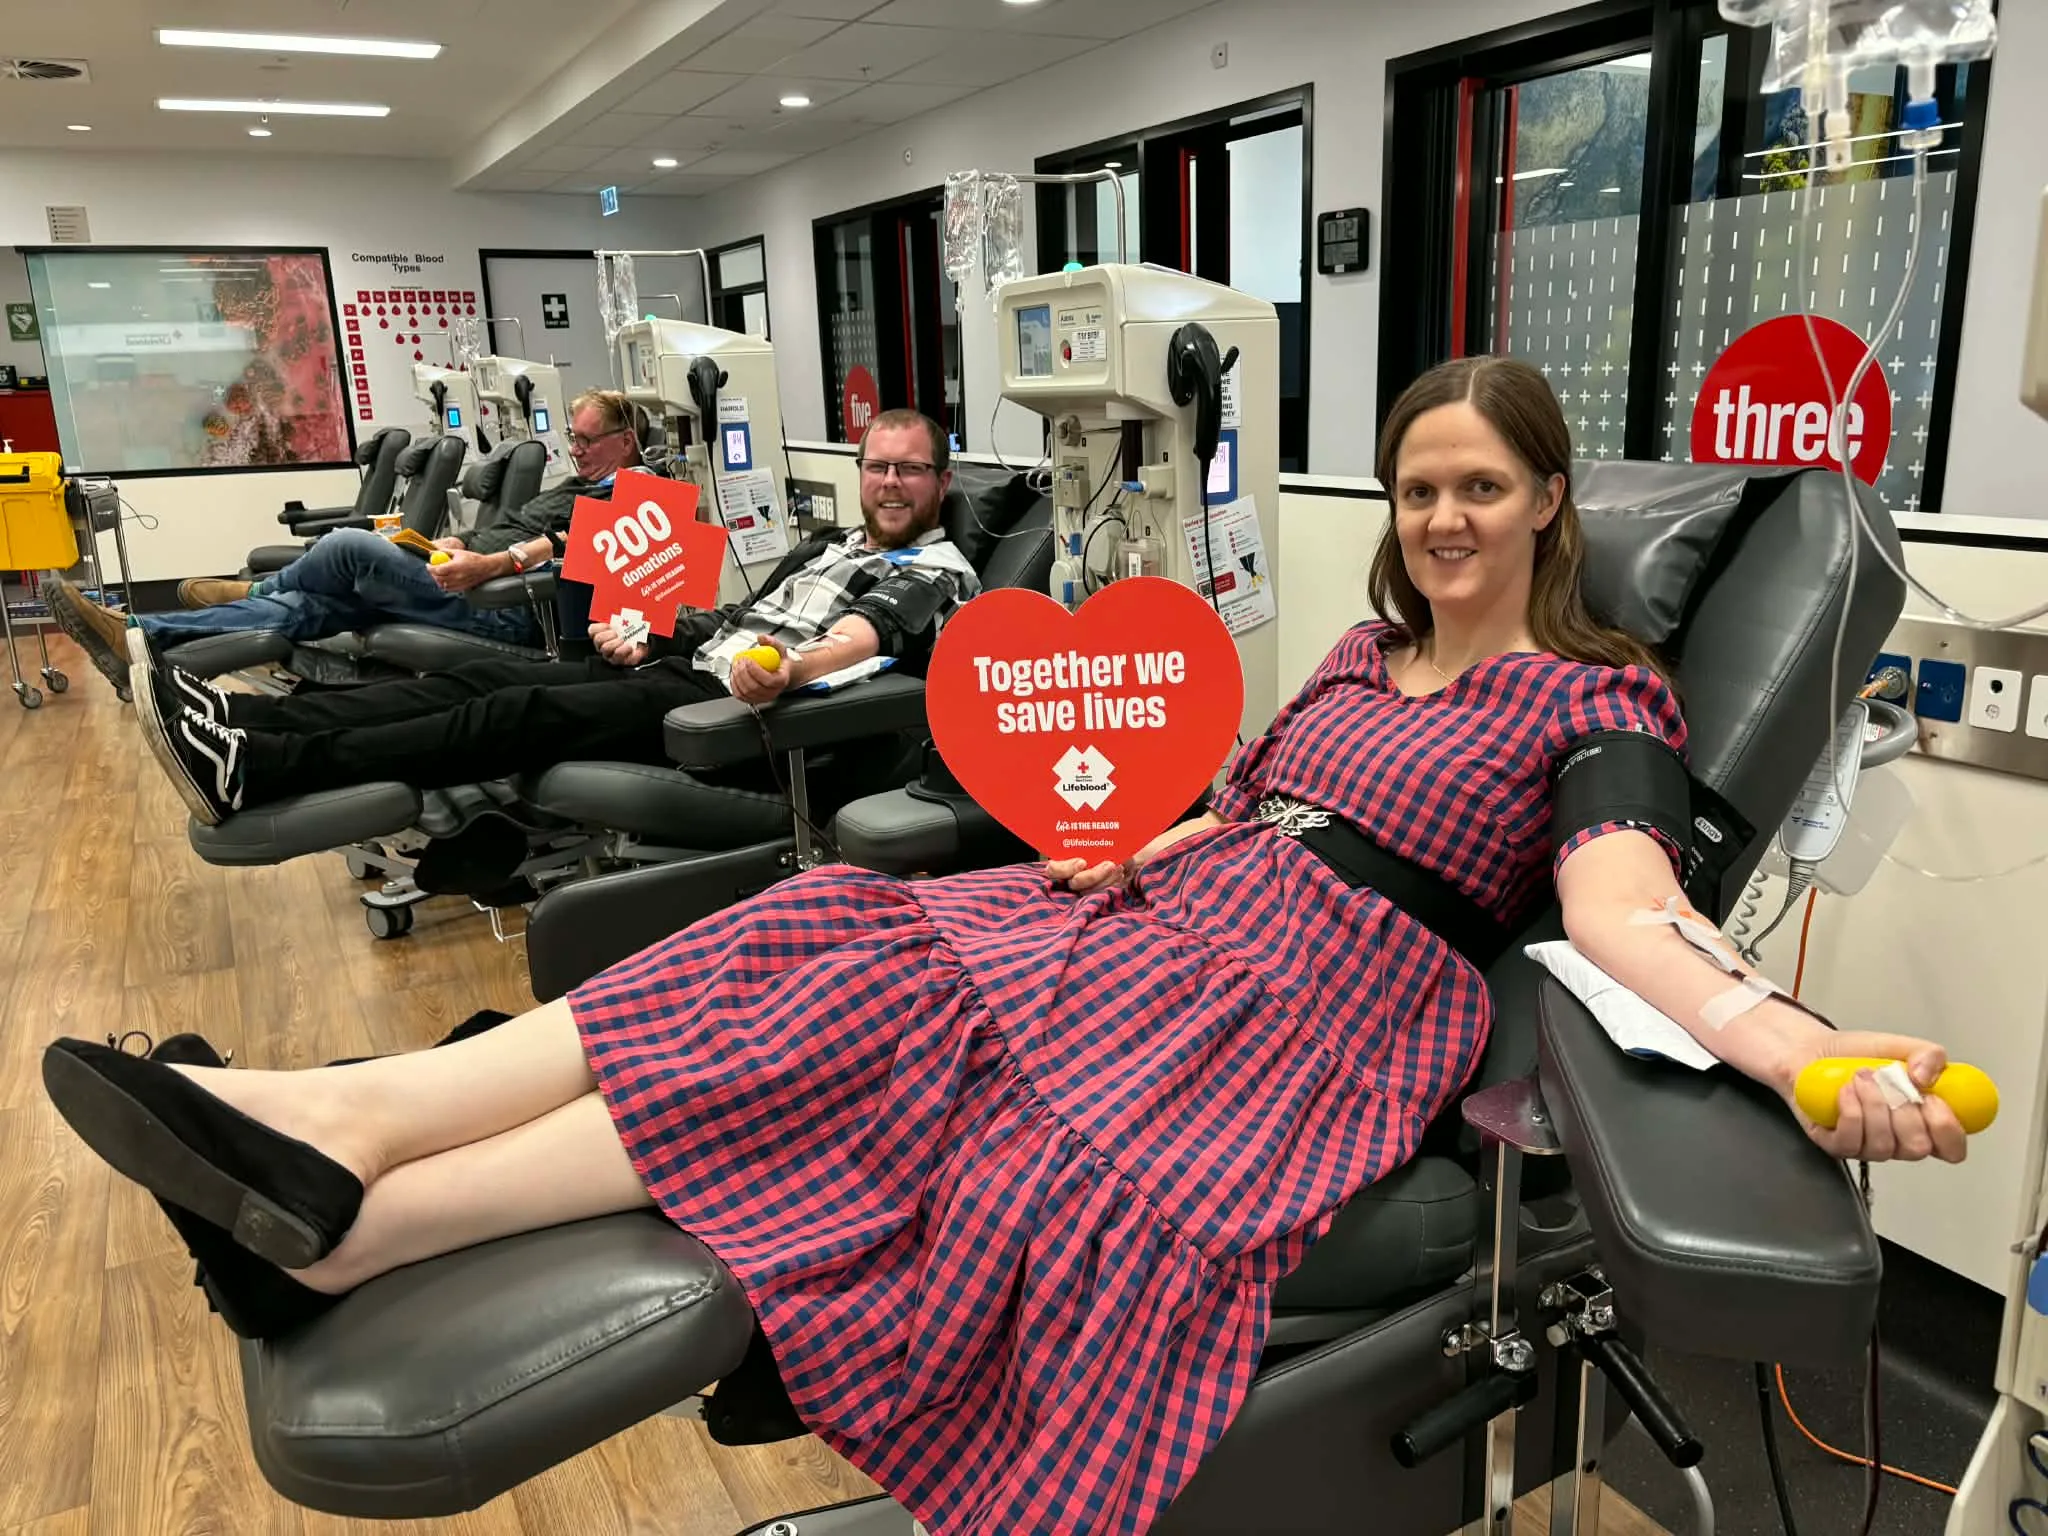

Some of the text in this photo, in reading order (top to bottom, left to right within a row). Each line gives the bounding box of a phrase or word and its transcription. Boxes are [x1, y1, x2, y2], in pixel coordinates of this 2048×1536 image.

[352, 253, 444, 264] Compatible Blood
[392, 263, 421, 273] Types
[851, 393, 871, 428] five
[1713, 385, 1865, 462] three
[592, 500, 672, 574] 200
[622, 542, 683, 588] donations
[973, 651, 1185, 697] Together we
[997, 692, 1167, 733] save lives
[1062, 783, 1107, 792] Lifeblood
[1078, 822, 1091, 831] THE
[1092, 821, 1120, 831] REASON
